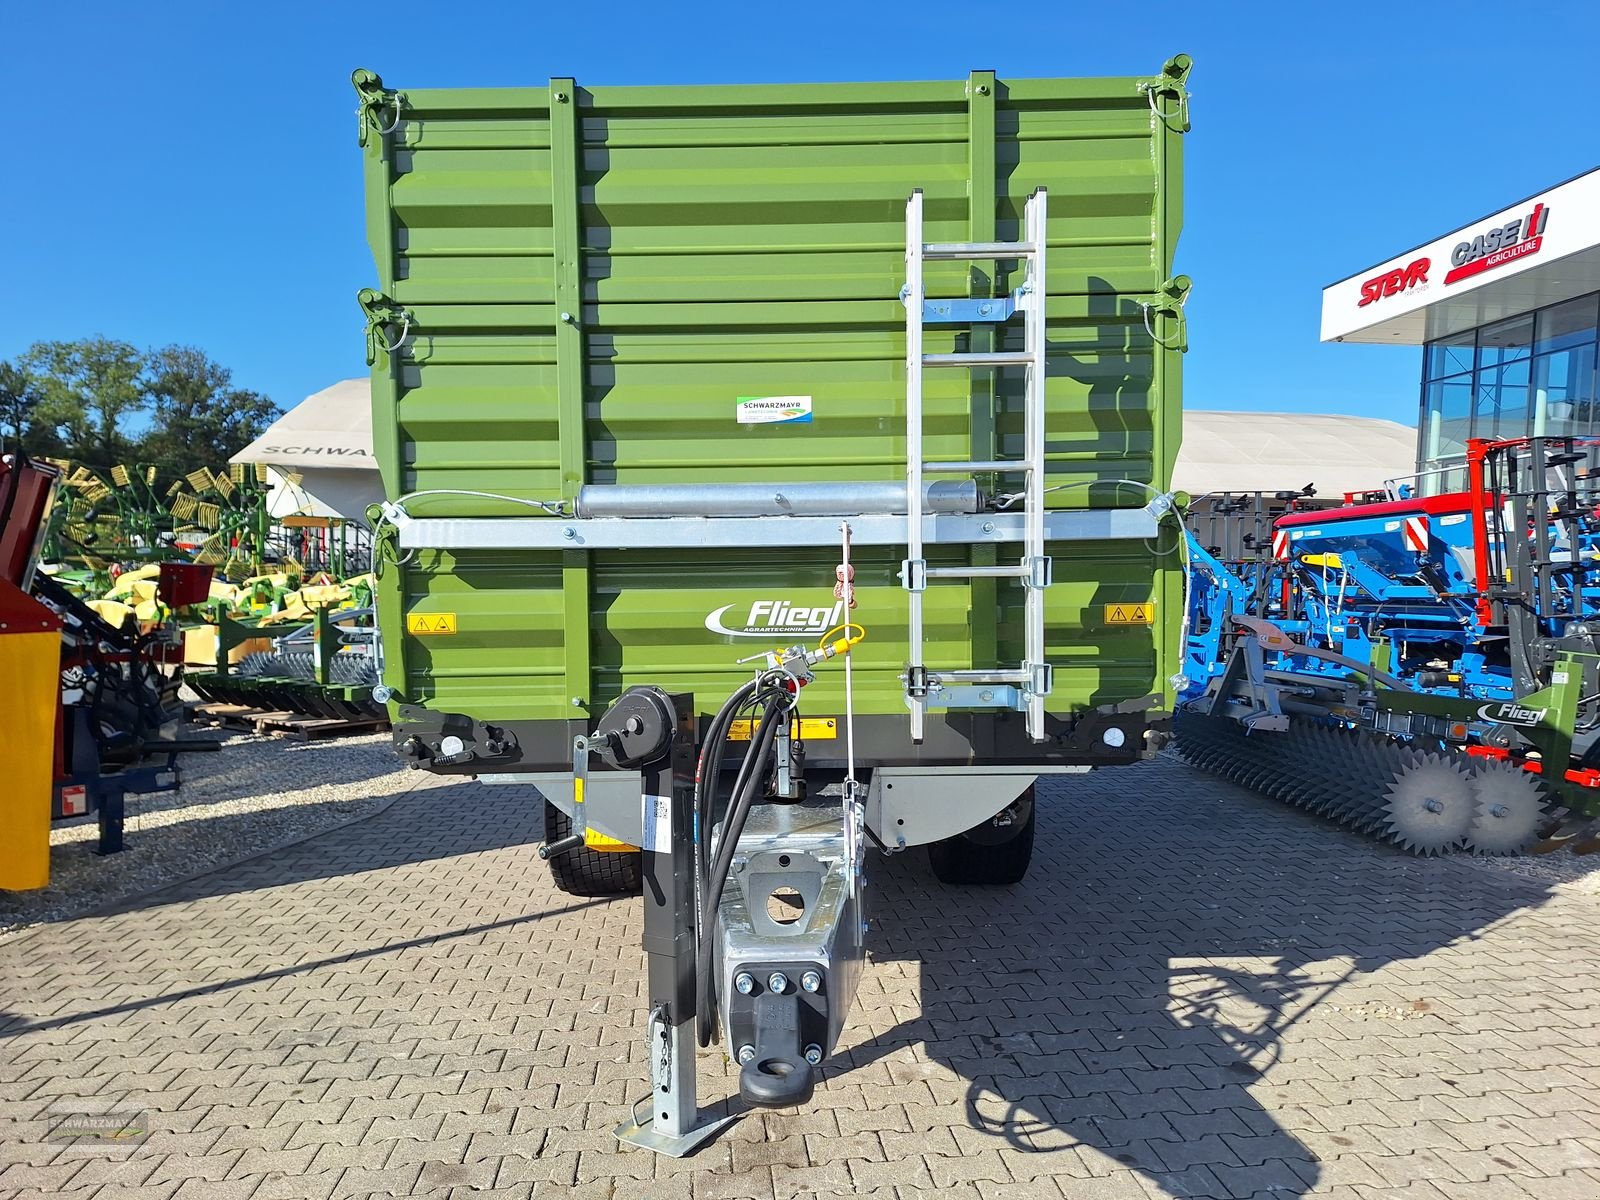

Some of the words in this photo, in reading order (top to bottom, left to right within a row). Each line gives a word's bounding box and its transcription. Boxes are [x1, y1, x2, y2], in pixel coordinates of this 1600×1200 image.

[1450, 219, 1522, 268] CASE
[1486, 240, 1537, 266] AGRICULTURE
[1358, 257, 1431, 308] STEYR
[262, 446, 376, 457] SCHWA
[746, 600, 845, 632] Fliegl
[348, 632, 374, 644] Flieg
[1497, 703, 1548, 724] Fliegl
